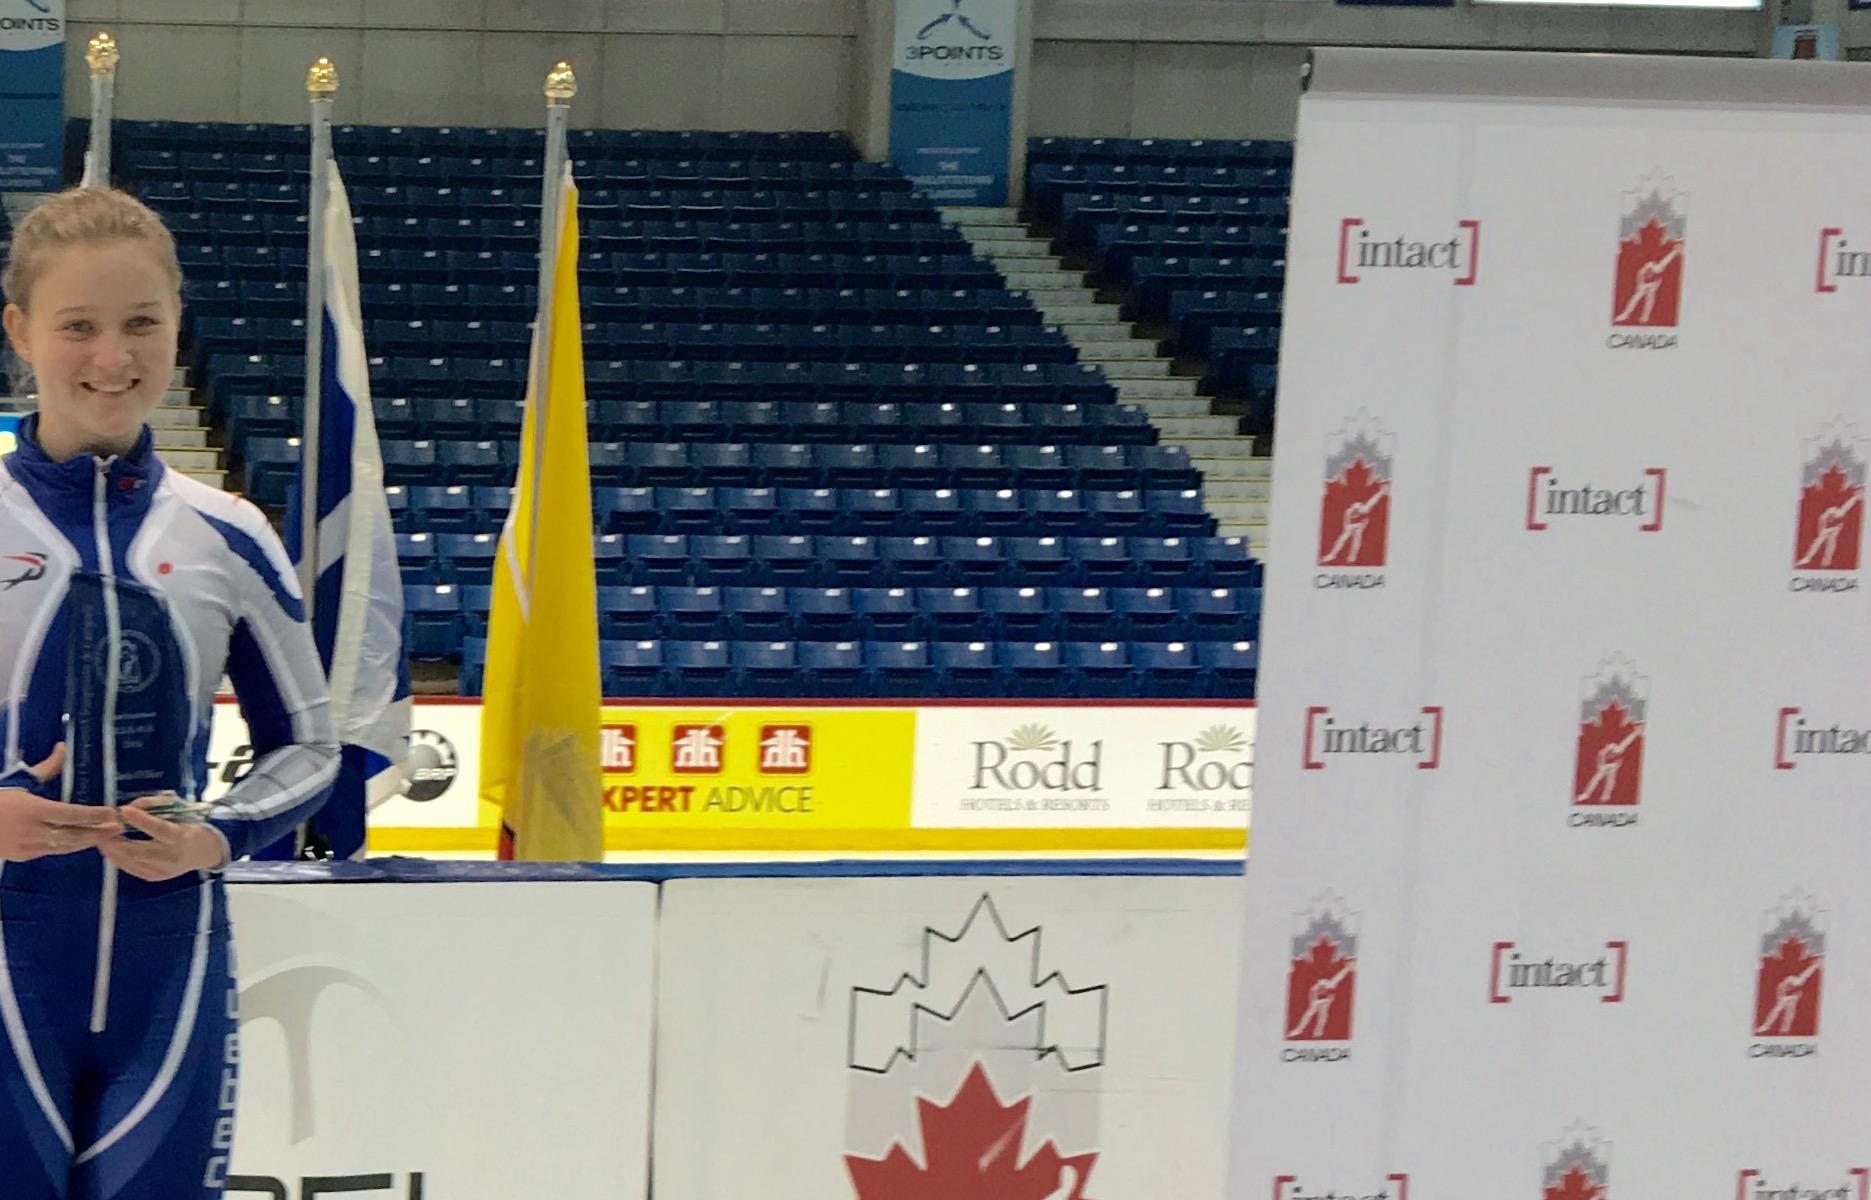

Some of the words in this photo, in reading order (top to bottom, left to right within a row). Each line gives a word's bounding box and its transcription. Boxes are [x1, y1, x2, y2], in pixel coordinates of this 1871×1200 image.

[905, 46, 1004, 60] 3POINTS
[968, 739, 1105, 792] Rodd
[602, 785, 696, 812] XPERT
[702, 786, 814, 812] ADVICE
